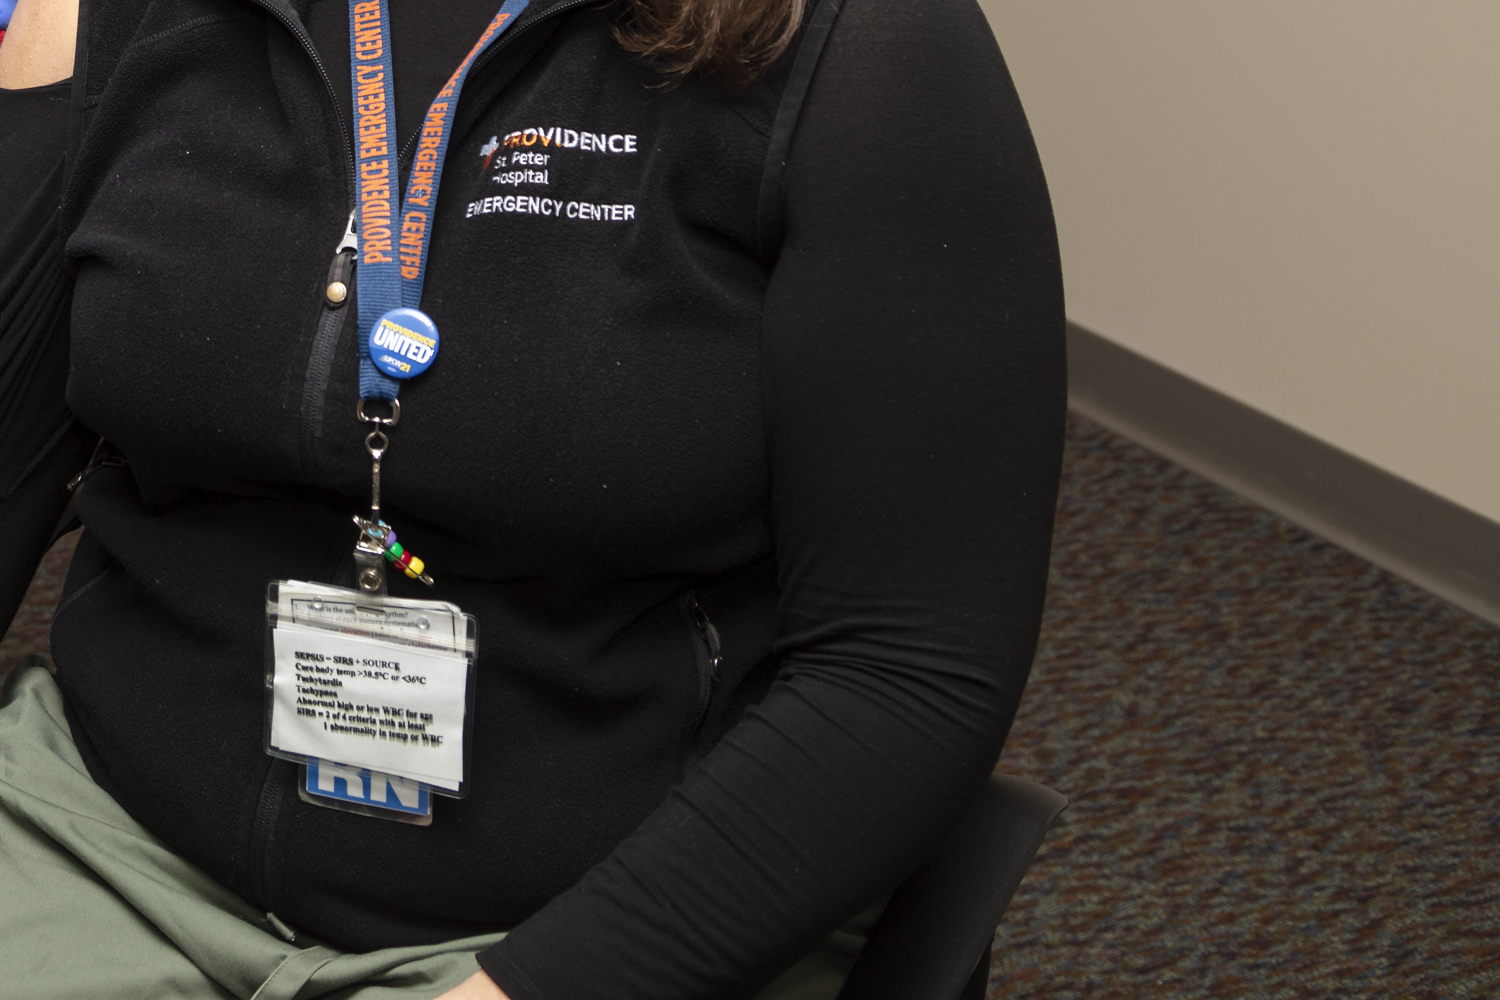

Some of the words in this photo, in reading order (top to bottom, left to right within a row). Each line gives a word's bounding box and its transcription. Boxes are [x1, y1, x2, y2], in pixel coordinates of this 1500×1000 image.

[354, 0, 384, 61] CENTER
[356, 64, 388, 158] EMERGENCY
[503, 127, 638, 153] PROVIDENCE
[408, 101, 449, 207] EMERGENCY
[511, 151, 551, 166] Peter
[360, 159, 393, 264] PROVIDENCE
[465, 195, 564, 219] EMERGENCY
[566, 201, 636, 221] CENTER
[373, 325, 433, 364] UNITED
[381, 318, 437, 349] PROVIDENCE
[340, 627, 370, 637] elevation
[295, 651, 324, 662] SEPSIS
[333, 655, 354, 666] SIRS
[362, 659, 400, 671] SOURCE
[295, 662, 314, 672] Core
[315, 664, 334, 676] body
[336, 668, 356, 678] temp
[295, 673, 343, 687] Tachycardia
[296, 684, 338, 699] Tachypnea
[296, 696, 335, 708] Abnormal
[337, 700, 354, 711] high
[366, 704, 380, 713] low
[382, 705, 404, 717] WBC
[406, 709, 418, 718] for
[420, 712, 434, 723] age
[296, 707, 316, 717] SIRS
[332, 712, 340, 720] of
[348, 714, 377, 725] criteria
[379, 718, 396, 727] with
[398, 720, 406, 729] at
[407, 720, 425, 731] least
[330, 722, 377, 737] abnormality
[379, 728, 387, 737] in
[388, 730, 408, 741] temp
[421, 733, 443, 744] WBC
